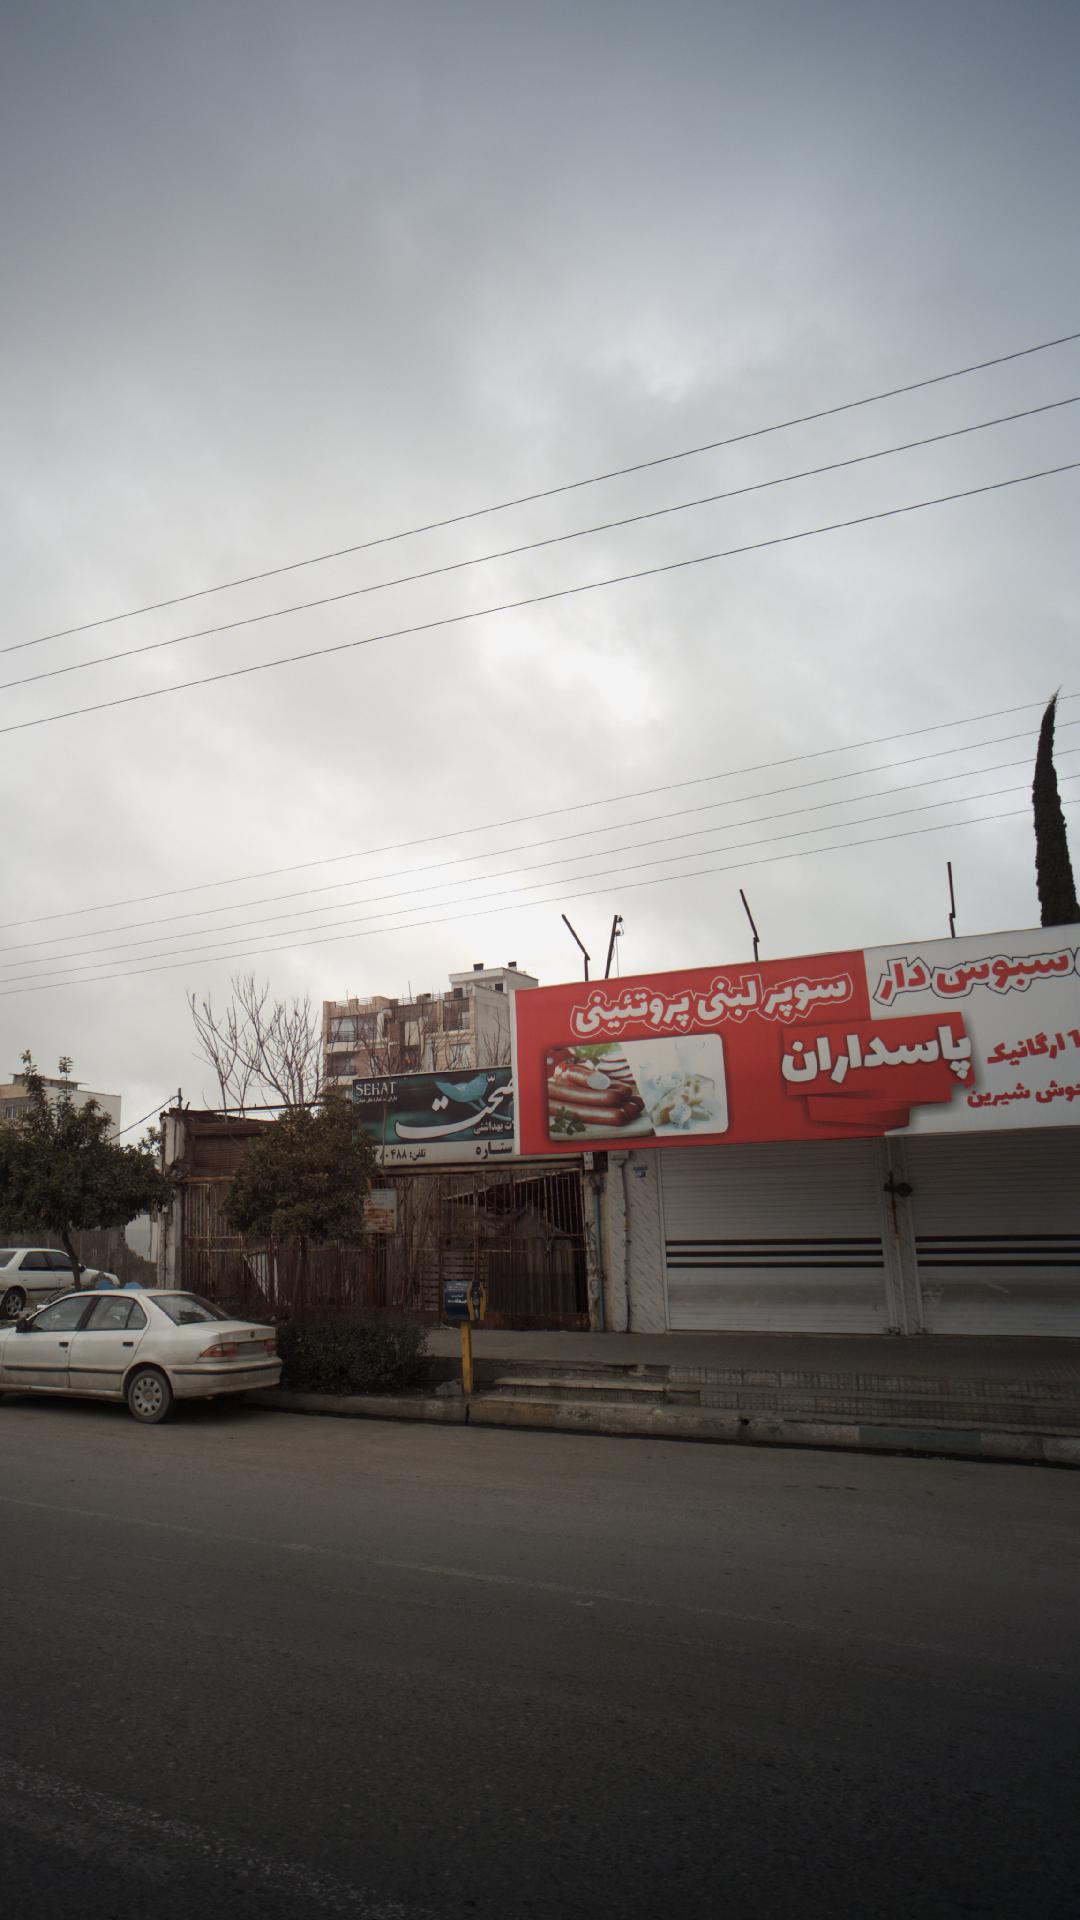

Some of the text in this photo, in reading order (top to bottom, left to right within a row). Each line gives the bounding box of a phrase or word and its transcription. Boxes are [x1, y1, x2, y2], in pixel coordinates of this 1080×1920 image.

[878, 953, 1070, 1003] سبوس دار
[573, 977, 848, 1034] سوپر لبنی پروتئینی
[780, 1025, 973, 1085] پاسداران
[986, 1031, 1066, 1066] ارگانیک
[354, 1081, 397, 1097] SEHAT
[966, 1082, 1031, 1108] شیرین
